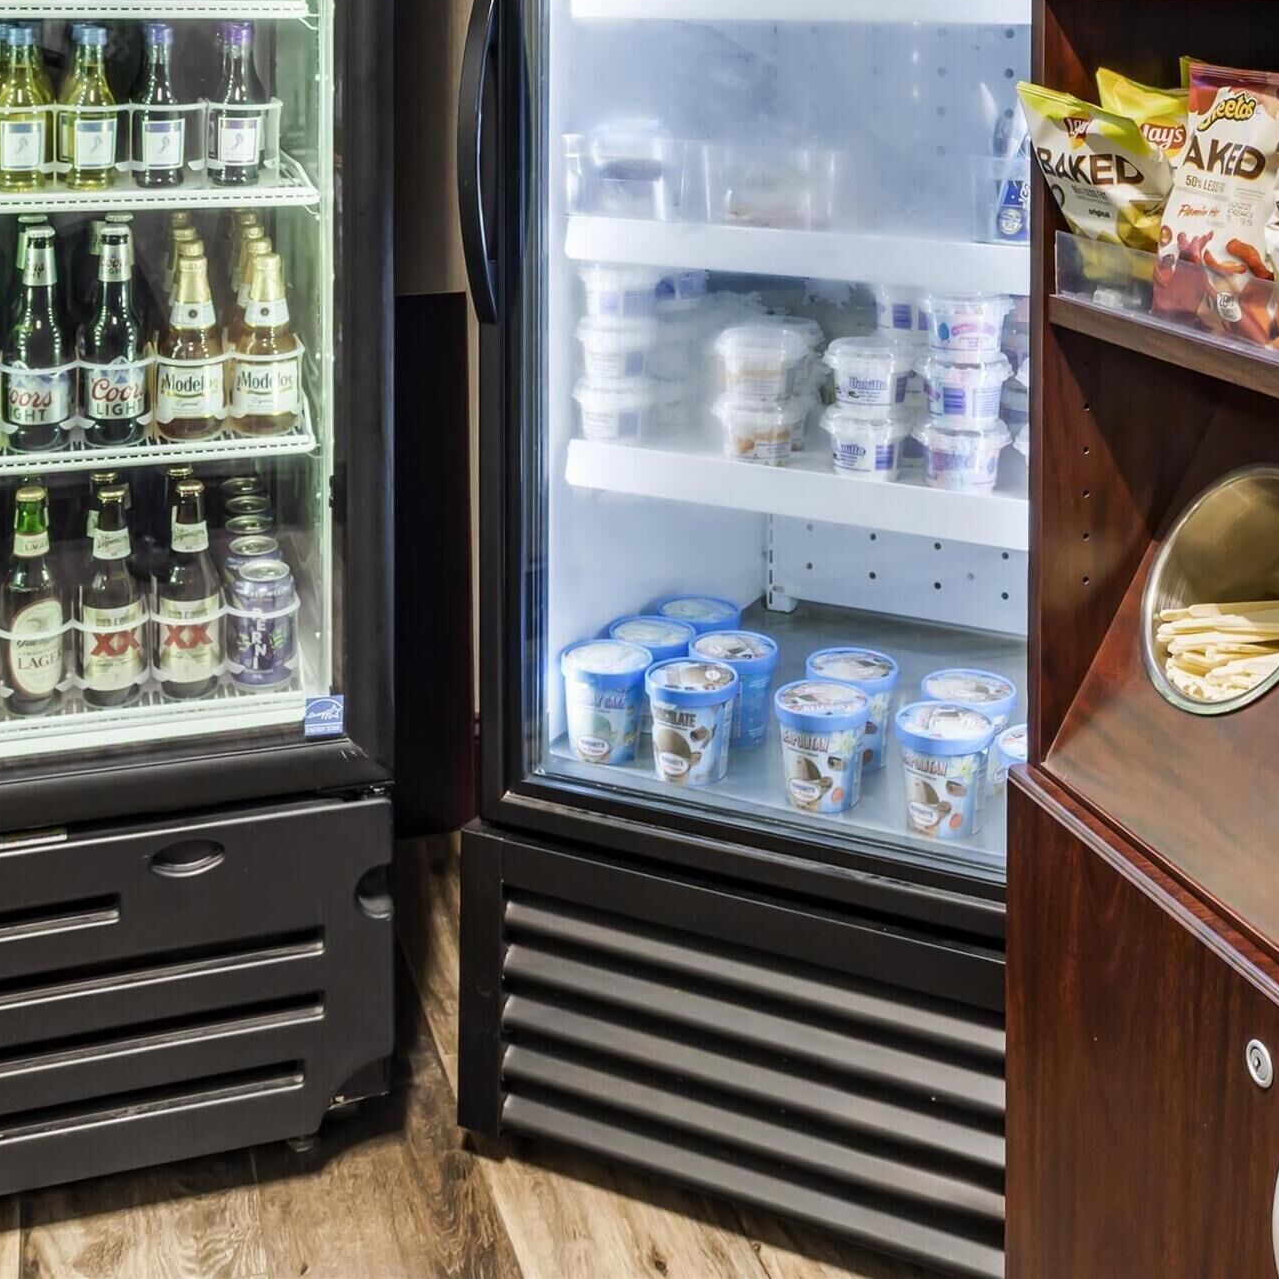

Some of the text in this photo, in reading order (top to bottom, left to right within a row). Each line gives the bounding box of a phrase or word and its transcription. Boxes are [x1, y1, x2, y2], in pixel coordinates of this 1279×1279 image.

[1036, 147, 1145, 186] BAKED
[1182, 134, 1267, 181] AKED
[8, 387, 53, 407] oors
[9, 408, 47, 422] IGHT
[90, 626, 142, 658] XX
[163, 624, 214, 651] XX
[18, 649, 63, 671] LAGER
